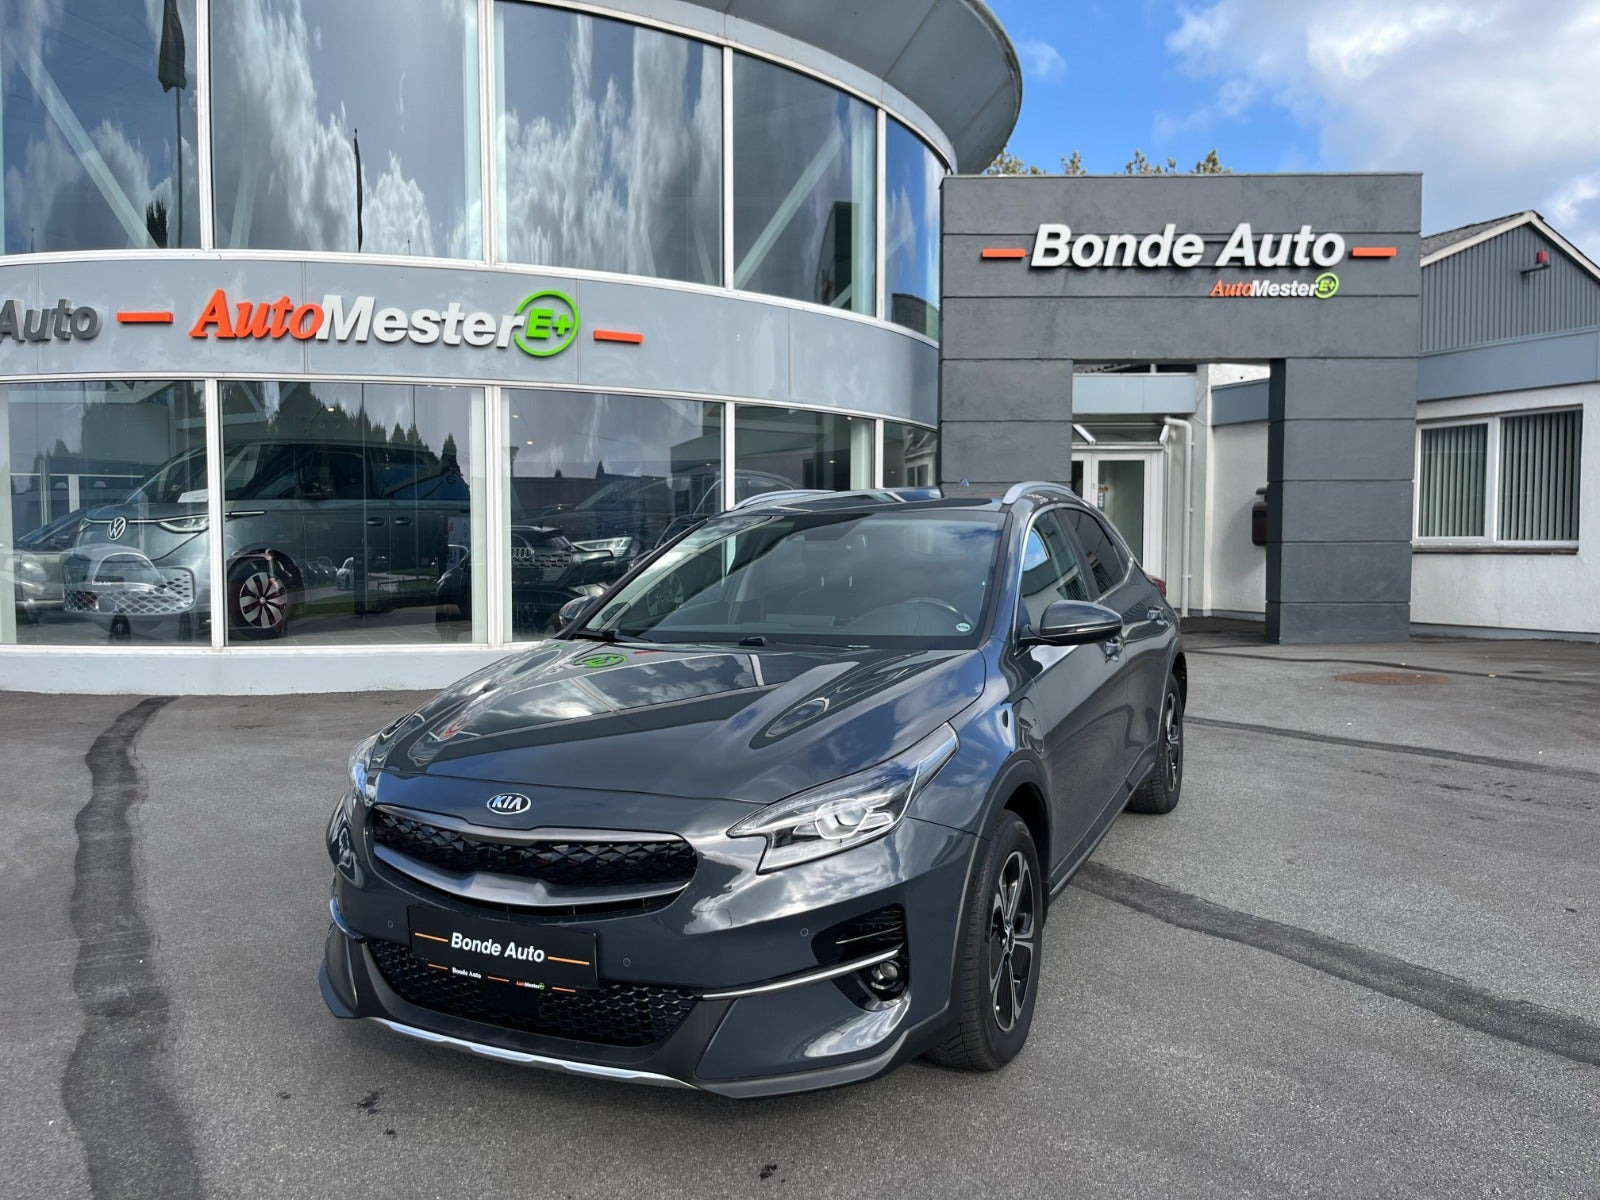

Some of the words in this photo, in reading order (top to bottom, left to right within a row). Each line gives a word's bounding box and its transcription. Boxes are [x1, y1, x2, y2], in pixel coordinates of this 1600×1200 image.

[1030, 223, 1206, 269] Bonde
[1214, 222, 1346, 269] Auto
[1210, 279, 1320, 297] AutoMester
[188, 288, 524, 348] AutoMester
[491, 795, 523, 810] KIA
[451, 932, 502, 956] Bonde
[504, 942, 545, 962] Auto
